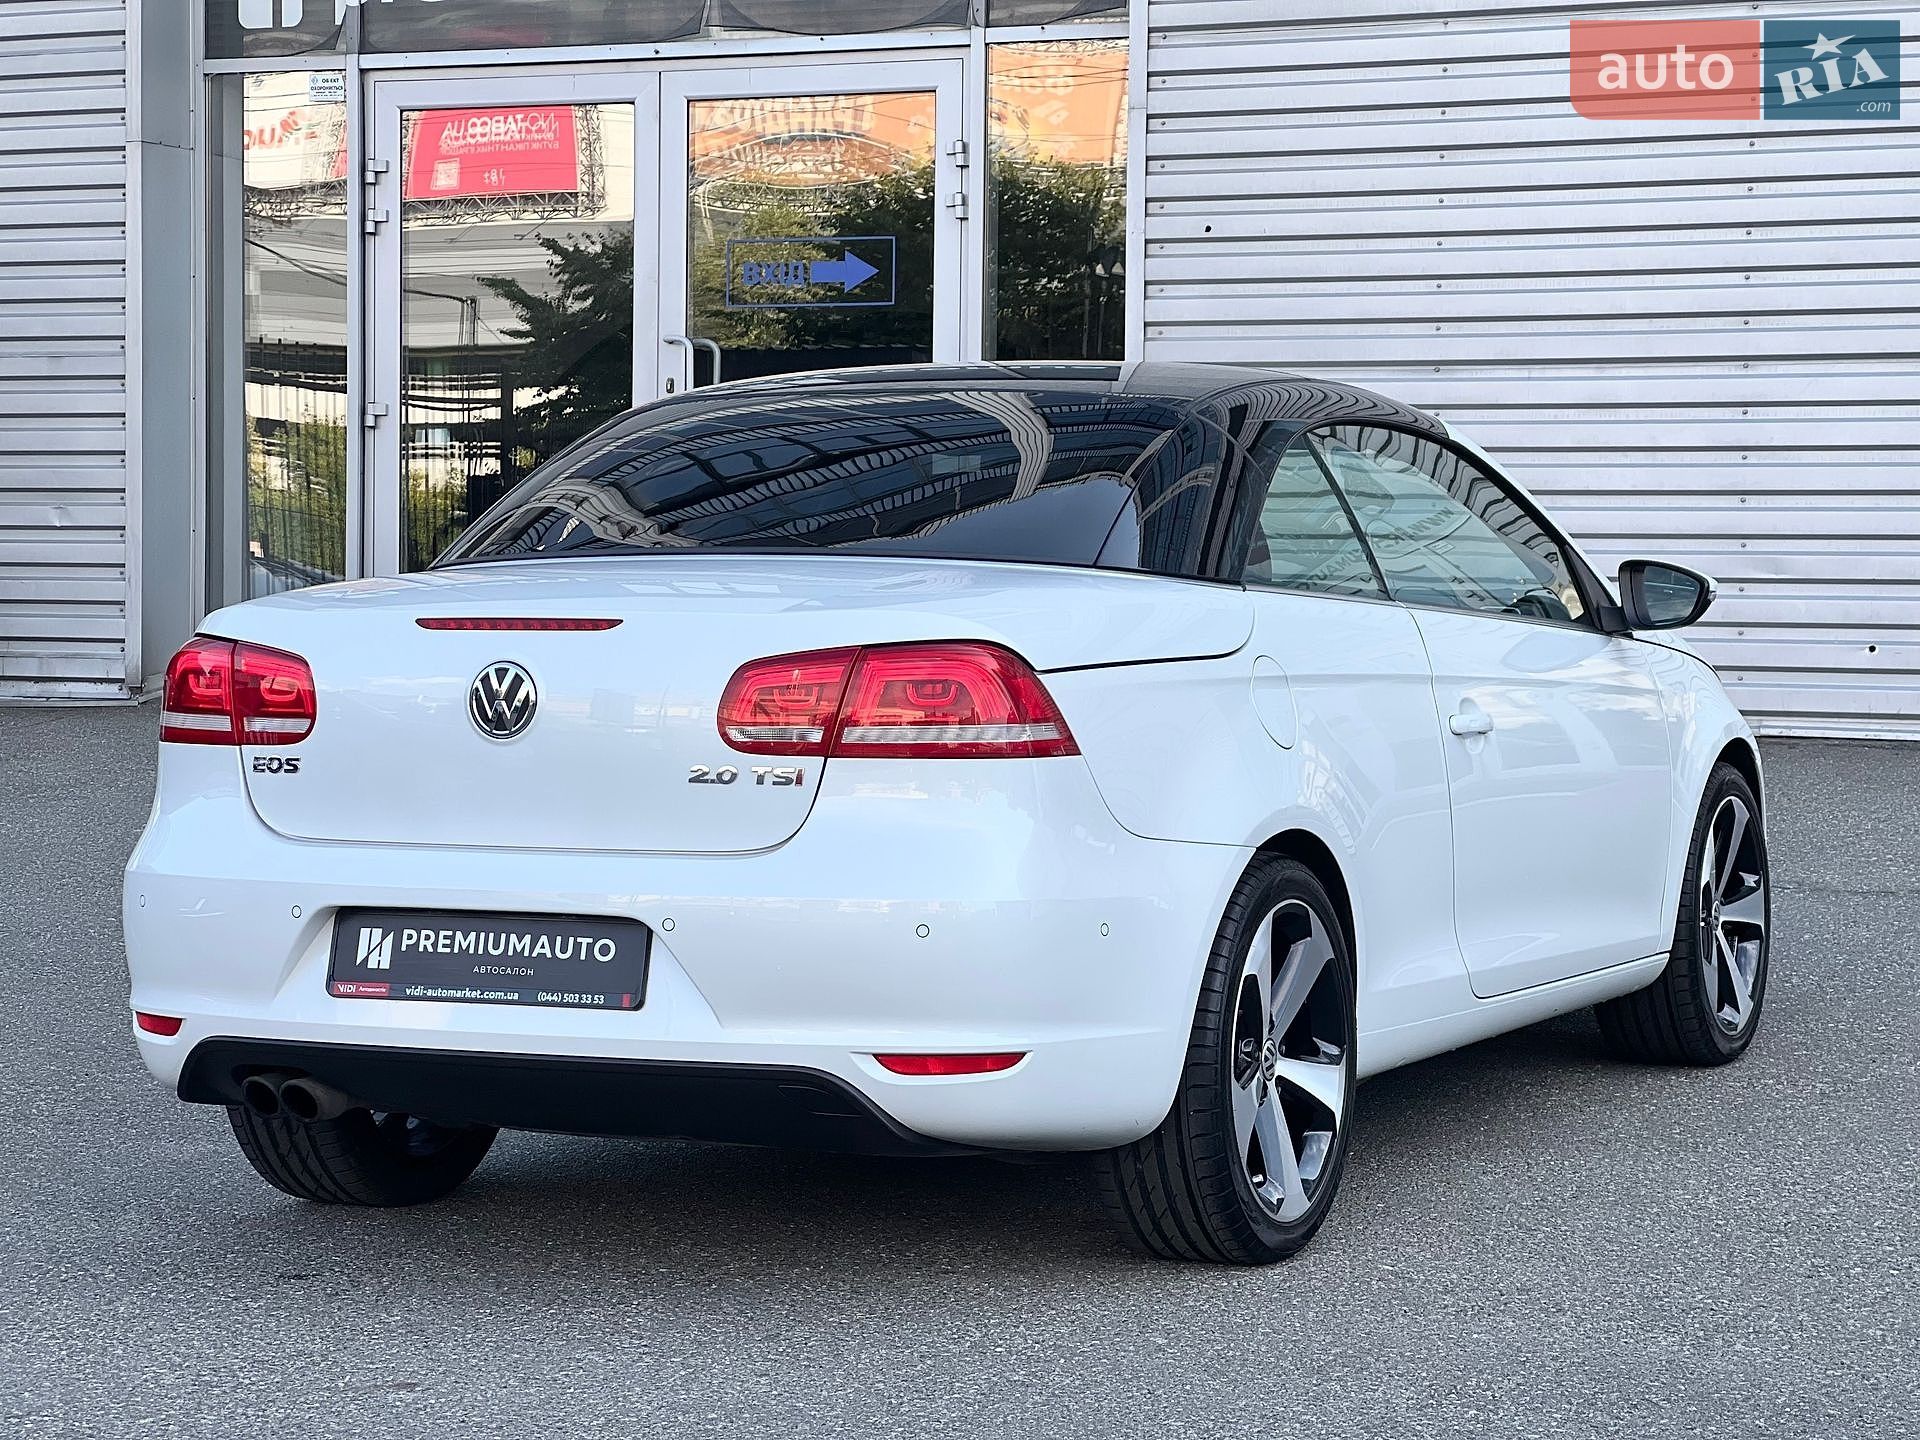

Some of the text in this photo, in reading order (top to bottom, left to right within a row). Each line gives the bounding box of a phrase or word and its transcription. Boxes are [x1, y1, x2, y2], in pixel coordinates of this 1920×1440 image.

[743, 261, 804, 288] ВХІД
[253, 756, 301, 774] EOS
[688, 764, 805, 787] 2.0 TSI
[401, 928, 616, 962] PREMIUMAUTO
[473, 965, 534, 976] АВТОСАЛОН
[337, 984, 356, 993] VIDI
[405, 985, 519, 1000] vidi-automarket.com.ua
[537, 991, 605, 1004] (044) 503 33 53
